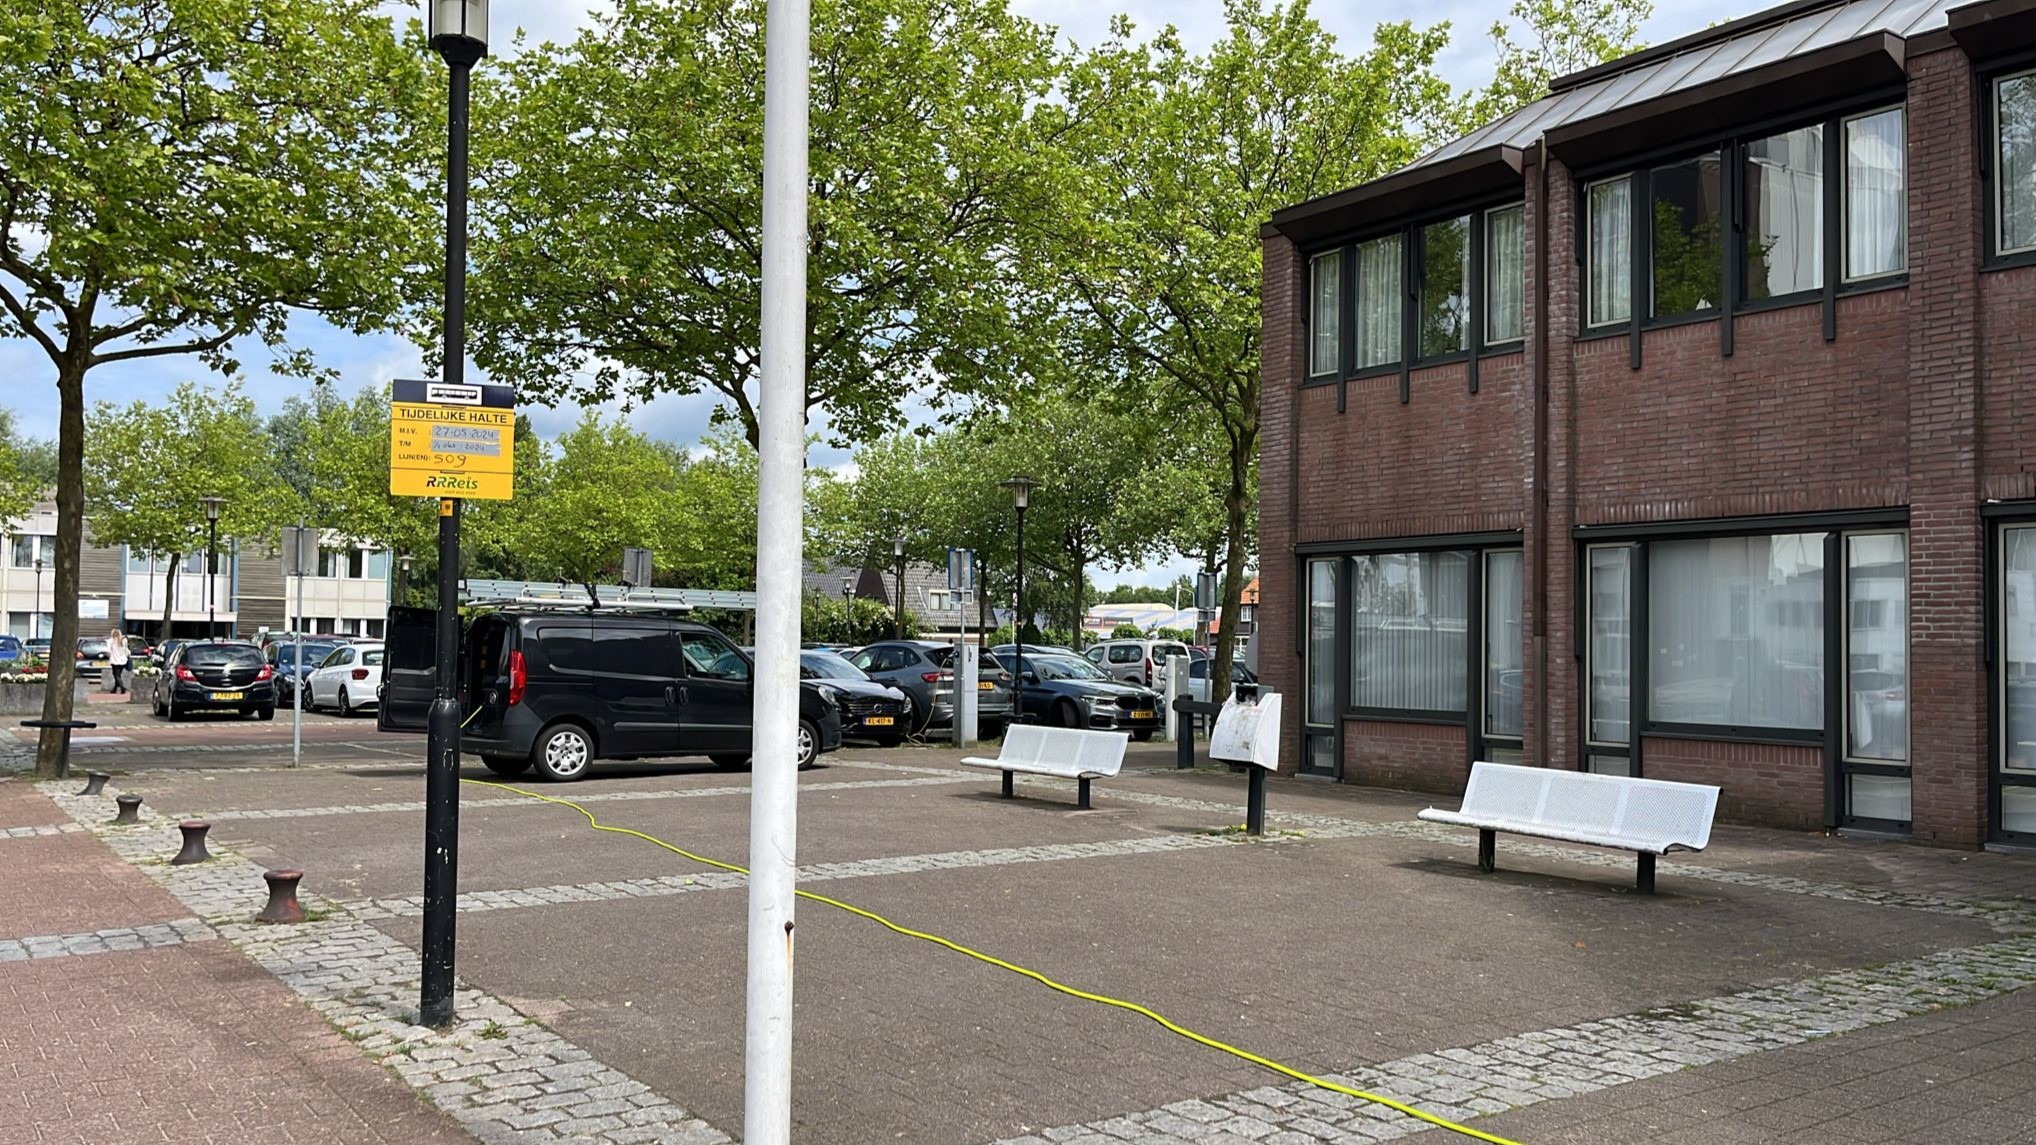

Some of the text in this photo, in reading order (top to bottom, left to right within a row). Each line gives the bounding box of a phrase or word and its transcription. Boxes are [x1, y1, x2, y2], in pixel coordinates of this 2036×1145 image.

[400, 408, 507, 424] TIJDELIJKE HALTE
[398, 453, 431, 462] LIJN(EN):
[426, 475, 478, 490] RRReis
